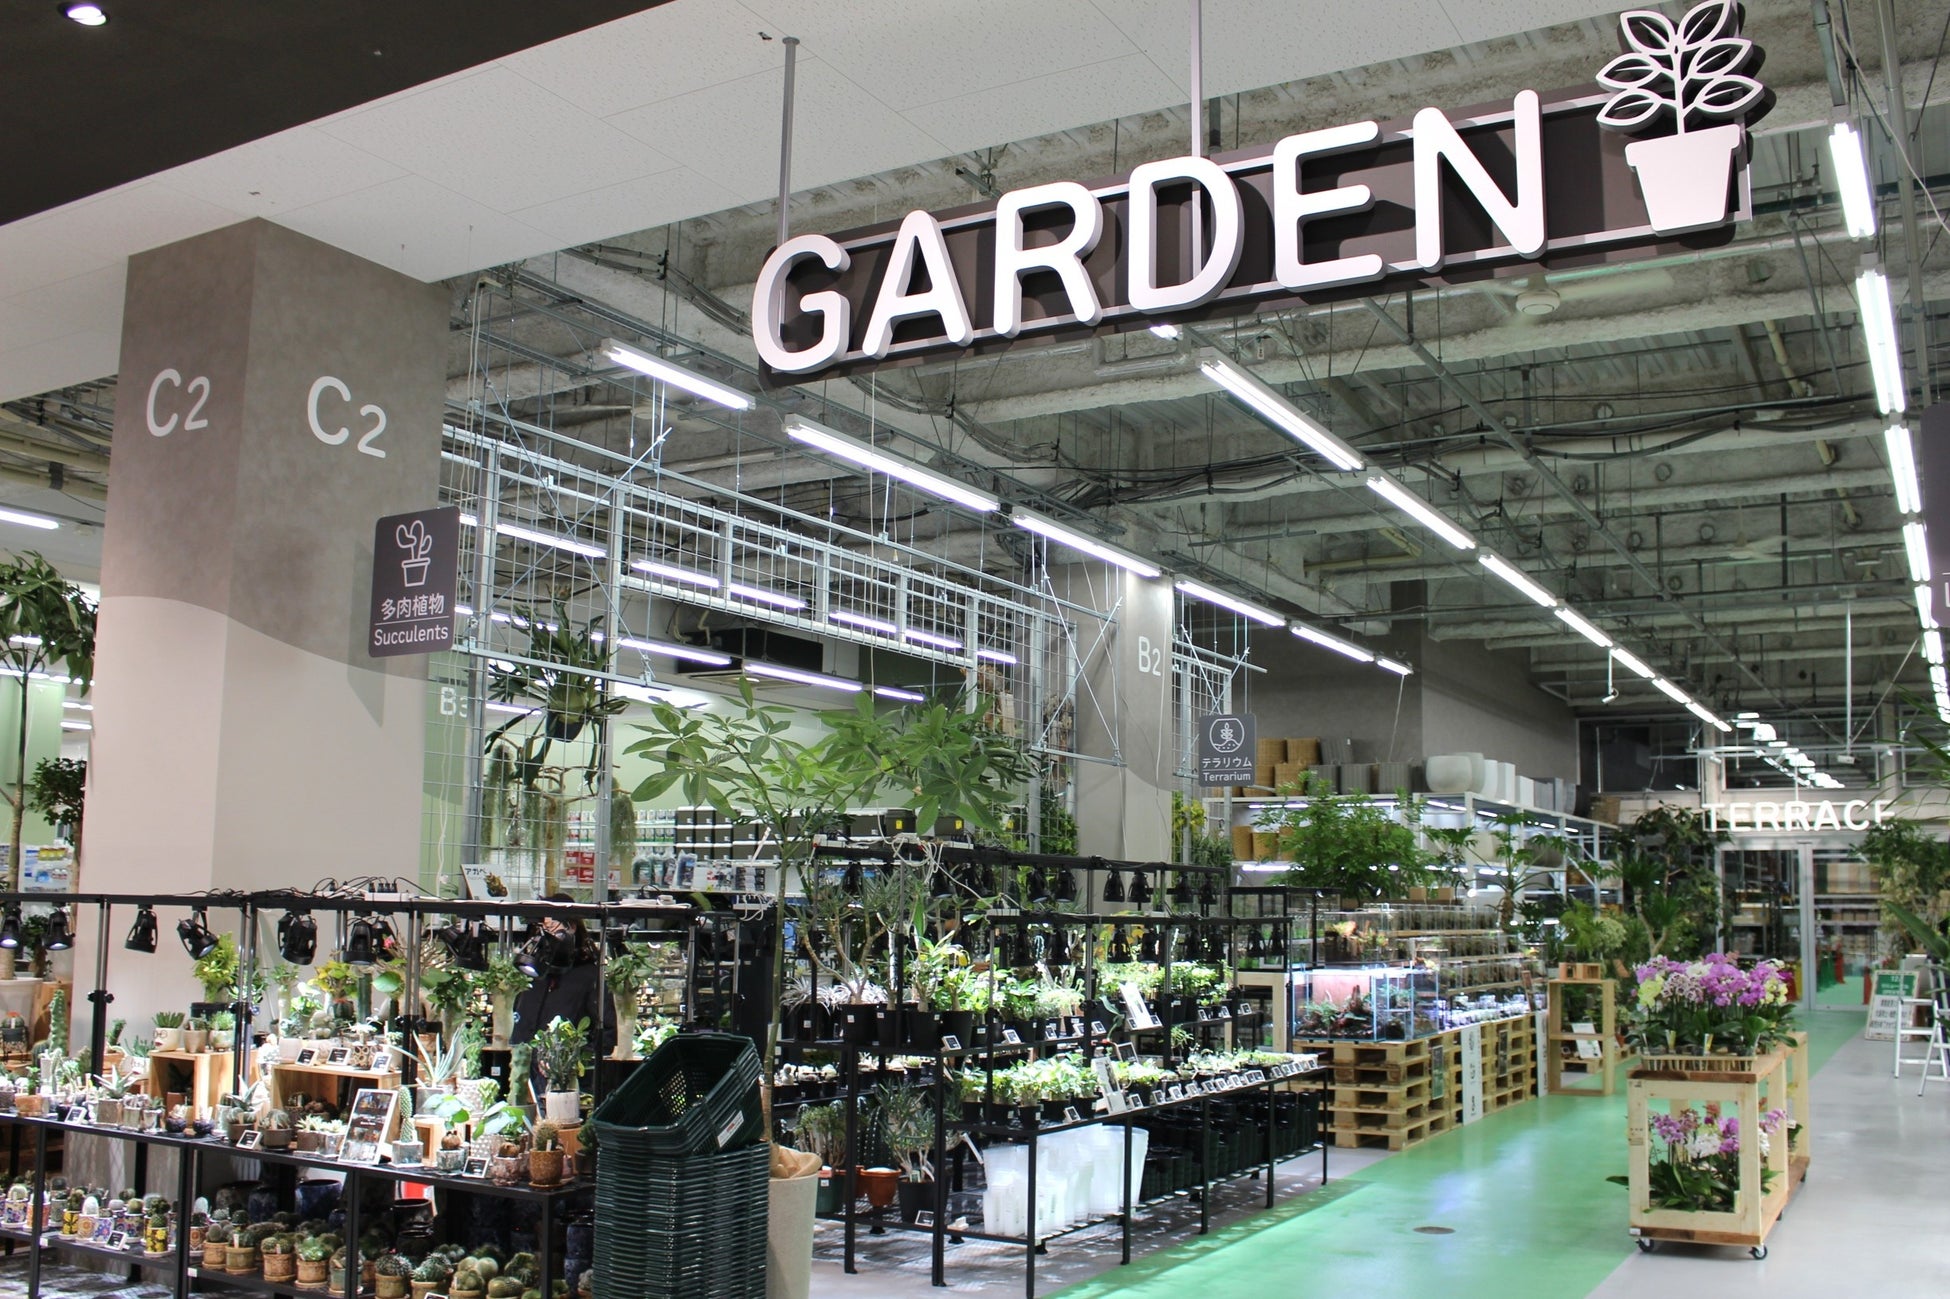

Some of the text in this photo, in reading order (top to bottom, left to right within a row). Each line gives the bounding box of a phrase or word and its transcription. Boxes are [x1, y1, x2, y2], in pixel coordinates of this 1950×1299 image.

[752, 89, 1547, 375] GARDEN
[147, 369, 210, 437] C2
[307, 375, 387, 459] C2
[381, 593, 445, 621] 多肉植物
[374, 625, 449, 646] Succulents
[1138, 636, 1161, 676] B2
[1202, 757, 1252, 768] テラリウム
[1203, 772, 1251, 782] Terrarium
